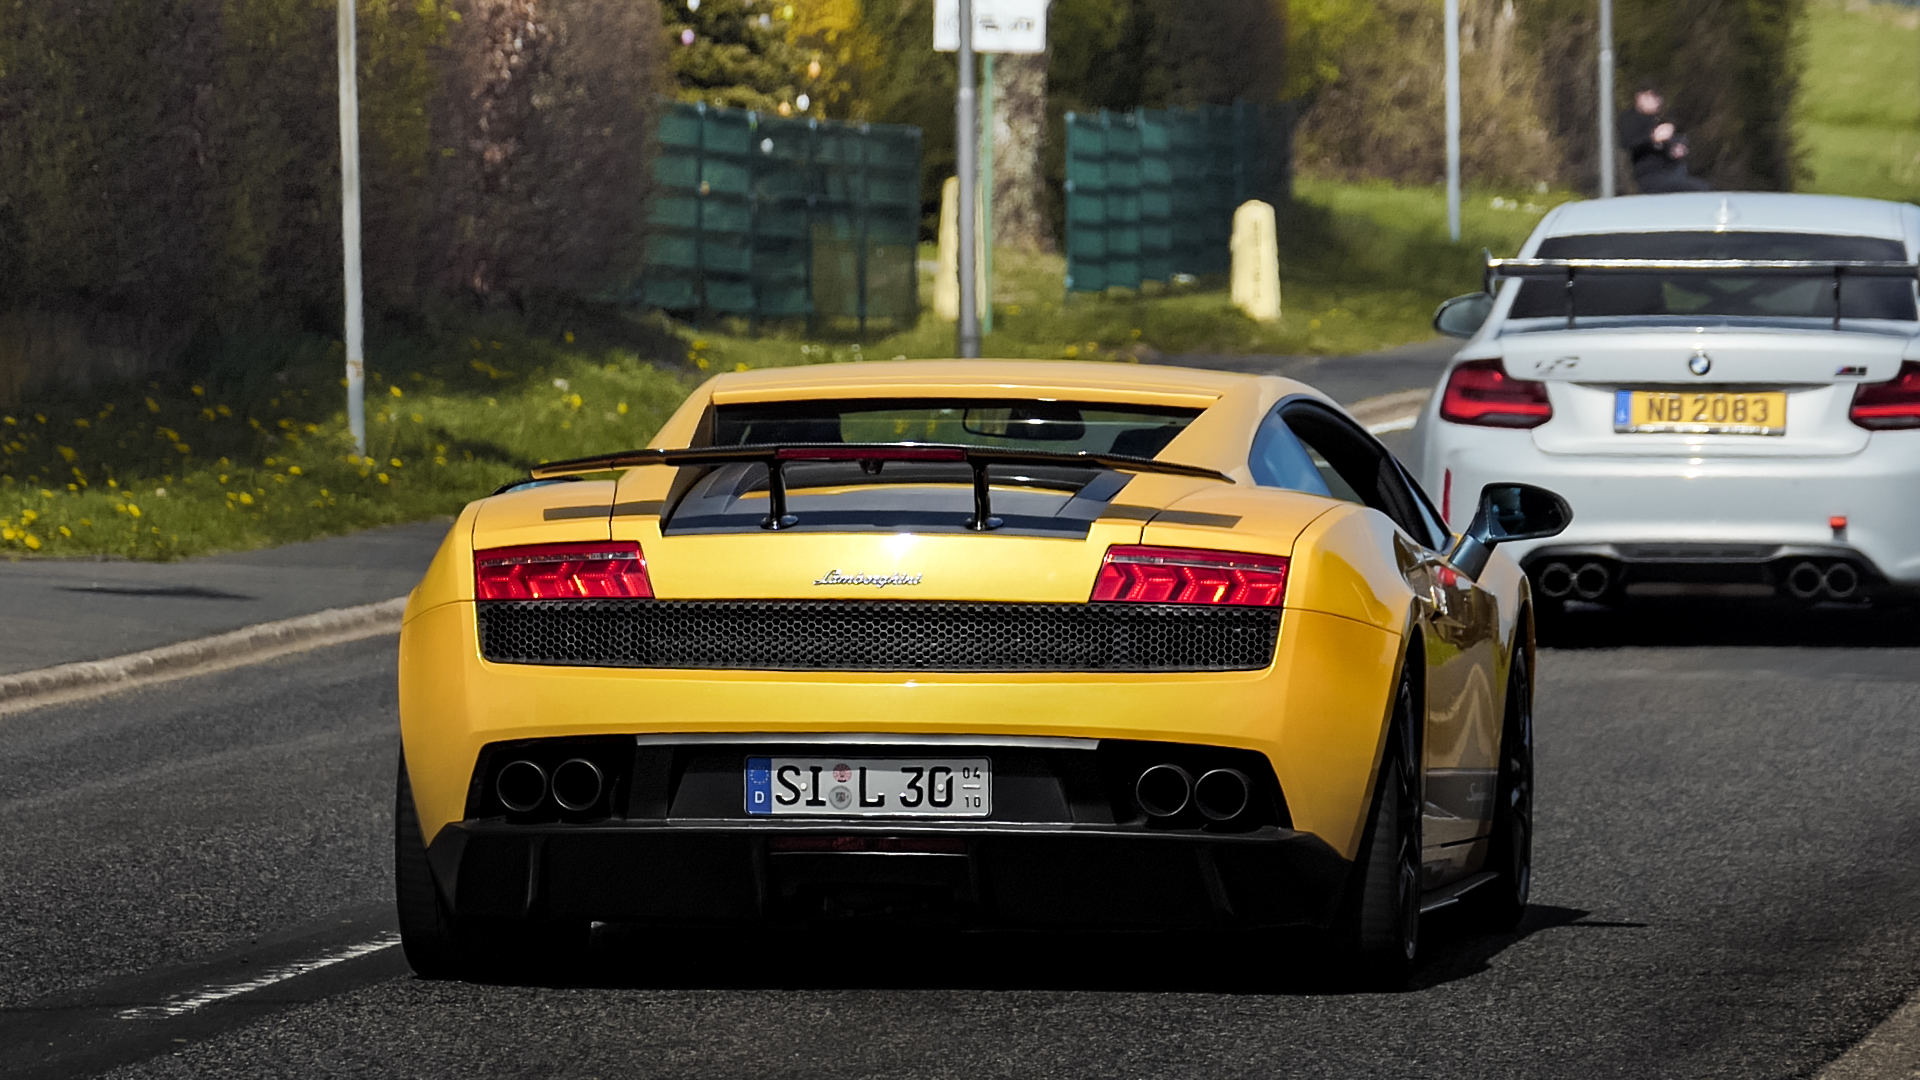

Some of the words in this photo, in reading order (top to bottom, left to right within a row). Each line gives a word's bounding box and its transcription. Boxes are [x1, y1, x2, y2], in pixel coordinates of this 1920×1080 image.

[1647, 393, 1683, 422] NB
[1692, 394, 1770, 423] 2083
[813, 569, 922, 588] Lamborghini
[962, 767, 981, 779] 04
[775, 765, 827, 806] SI
[859, 766, 885, 807] L
[900, 766, 954, 807] 30
[754, 791, 765, 804] D
[964, 796, 981, 808] 10
